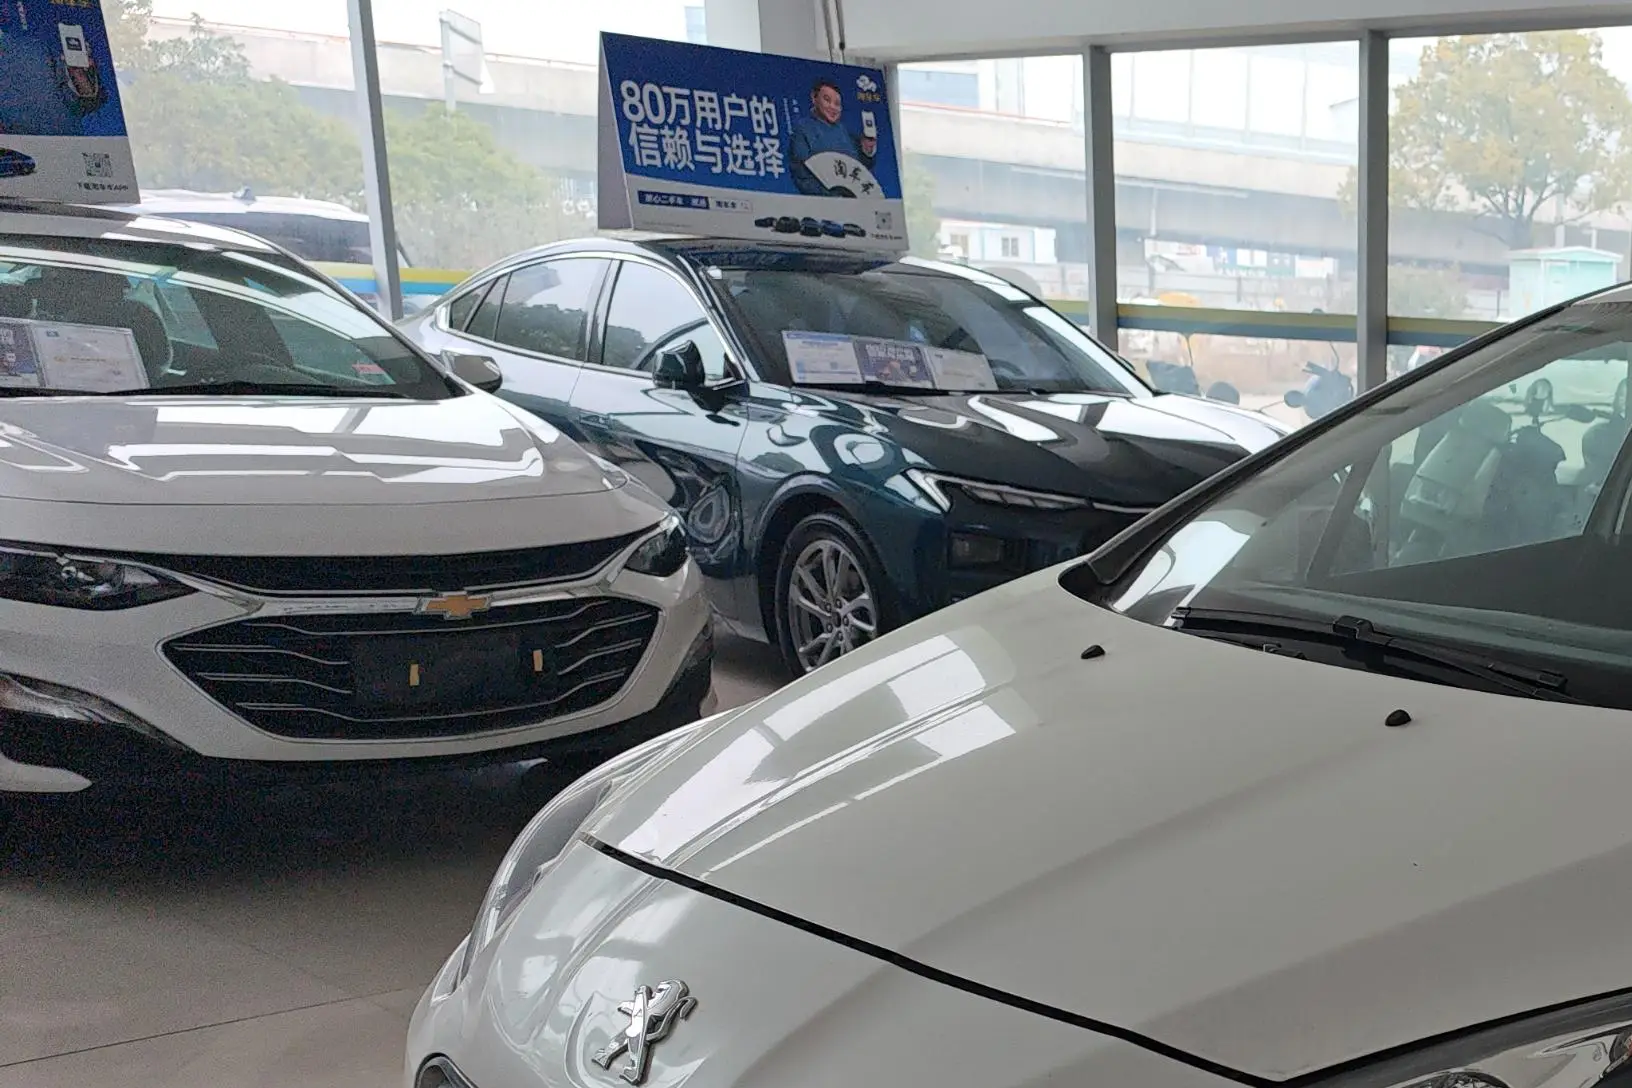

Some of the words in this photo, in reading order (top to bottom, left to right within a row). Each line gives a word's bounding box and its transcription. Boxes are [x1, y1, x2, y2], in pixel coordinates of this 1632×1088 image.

[619, 78, 779, 136] 80万用户的
[628, 120, 786, 180] 信赖与选择
